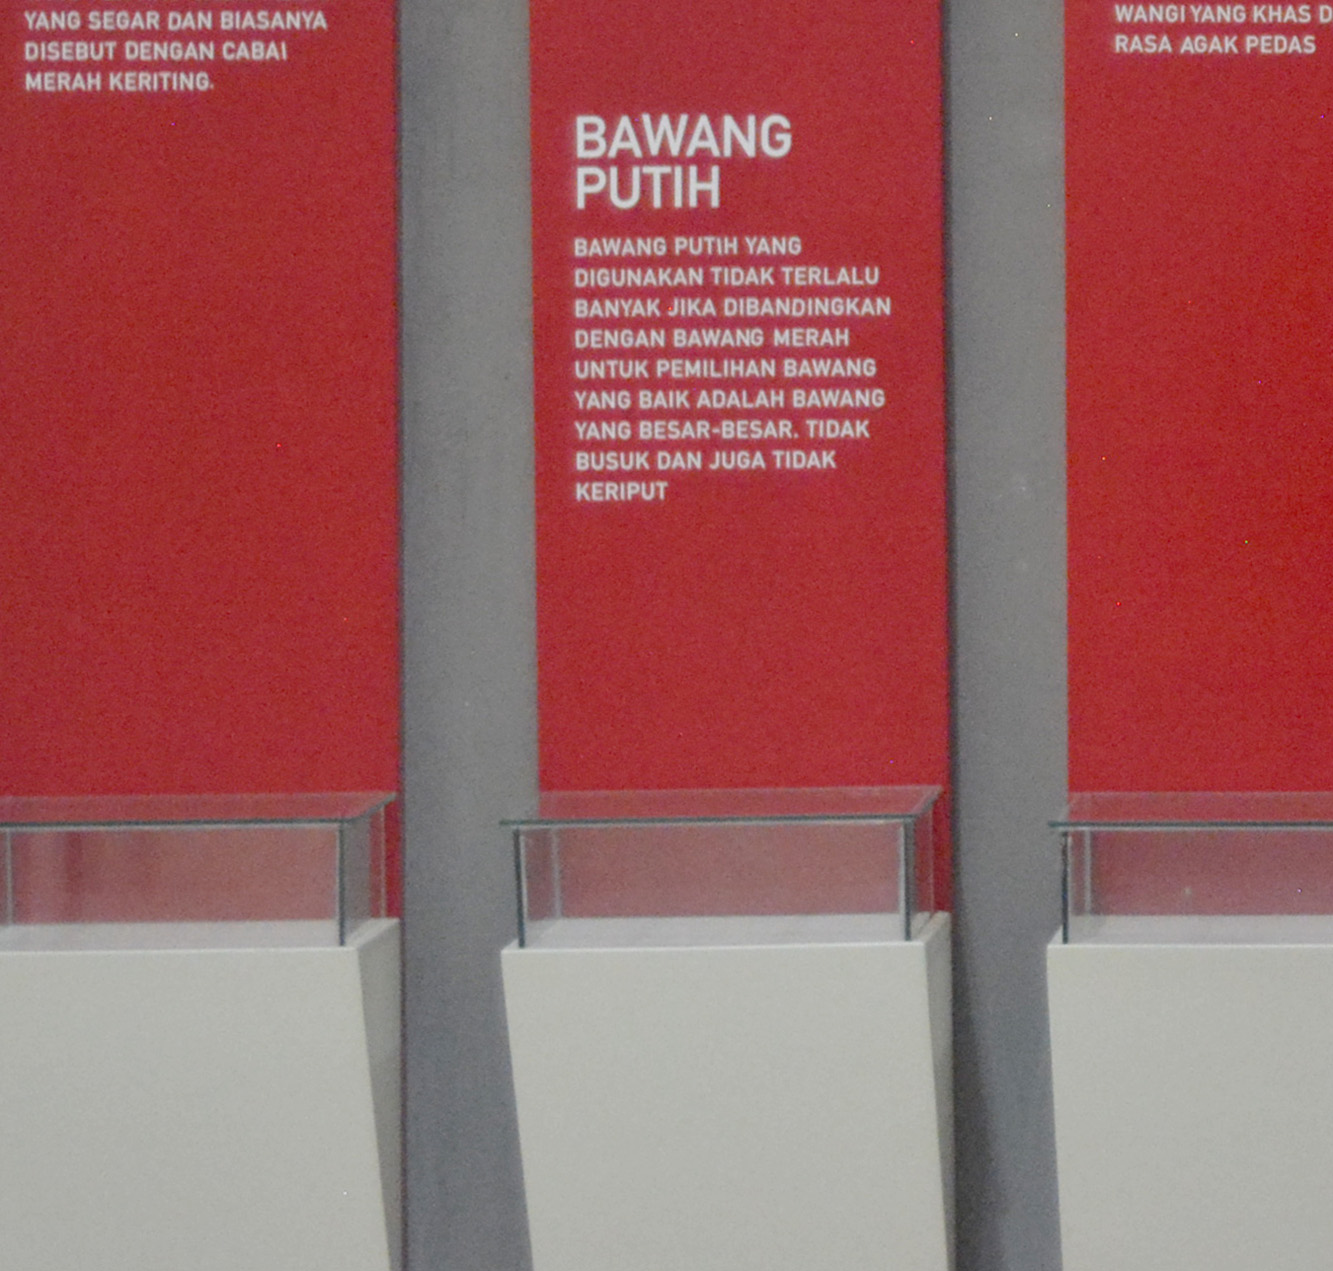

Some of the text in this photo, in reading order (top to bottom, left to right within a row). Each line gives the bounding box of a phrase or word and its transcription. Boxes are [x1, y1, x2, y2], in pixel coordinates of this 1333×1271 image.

[24, 10, 328, 31] YANG SEGAR DAN BIASANYA
[1113, 33, 1317, 55] RASA AGAK PEDAS
[575, 112, 793, 159] BAWANG
[574, 165, 720, 210] PUTIH
[574, 266, 880, 288] DIGUNAKAN TIDAK TERLALU
[574, 357, 877, 380] UNTUK PEMILIHAN BAWANG
[574, 388, 886, 410] YANG BAIK ADALAH BAWANG
[575, 449, 837, 472] BUSUK DAN JUGA TIDAK
